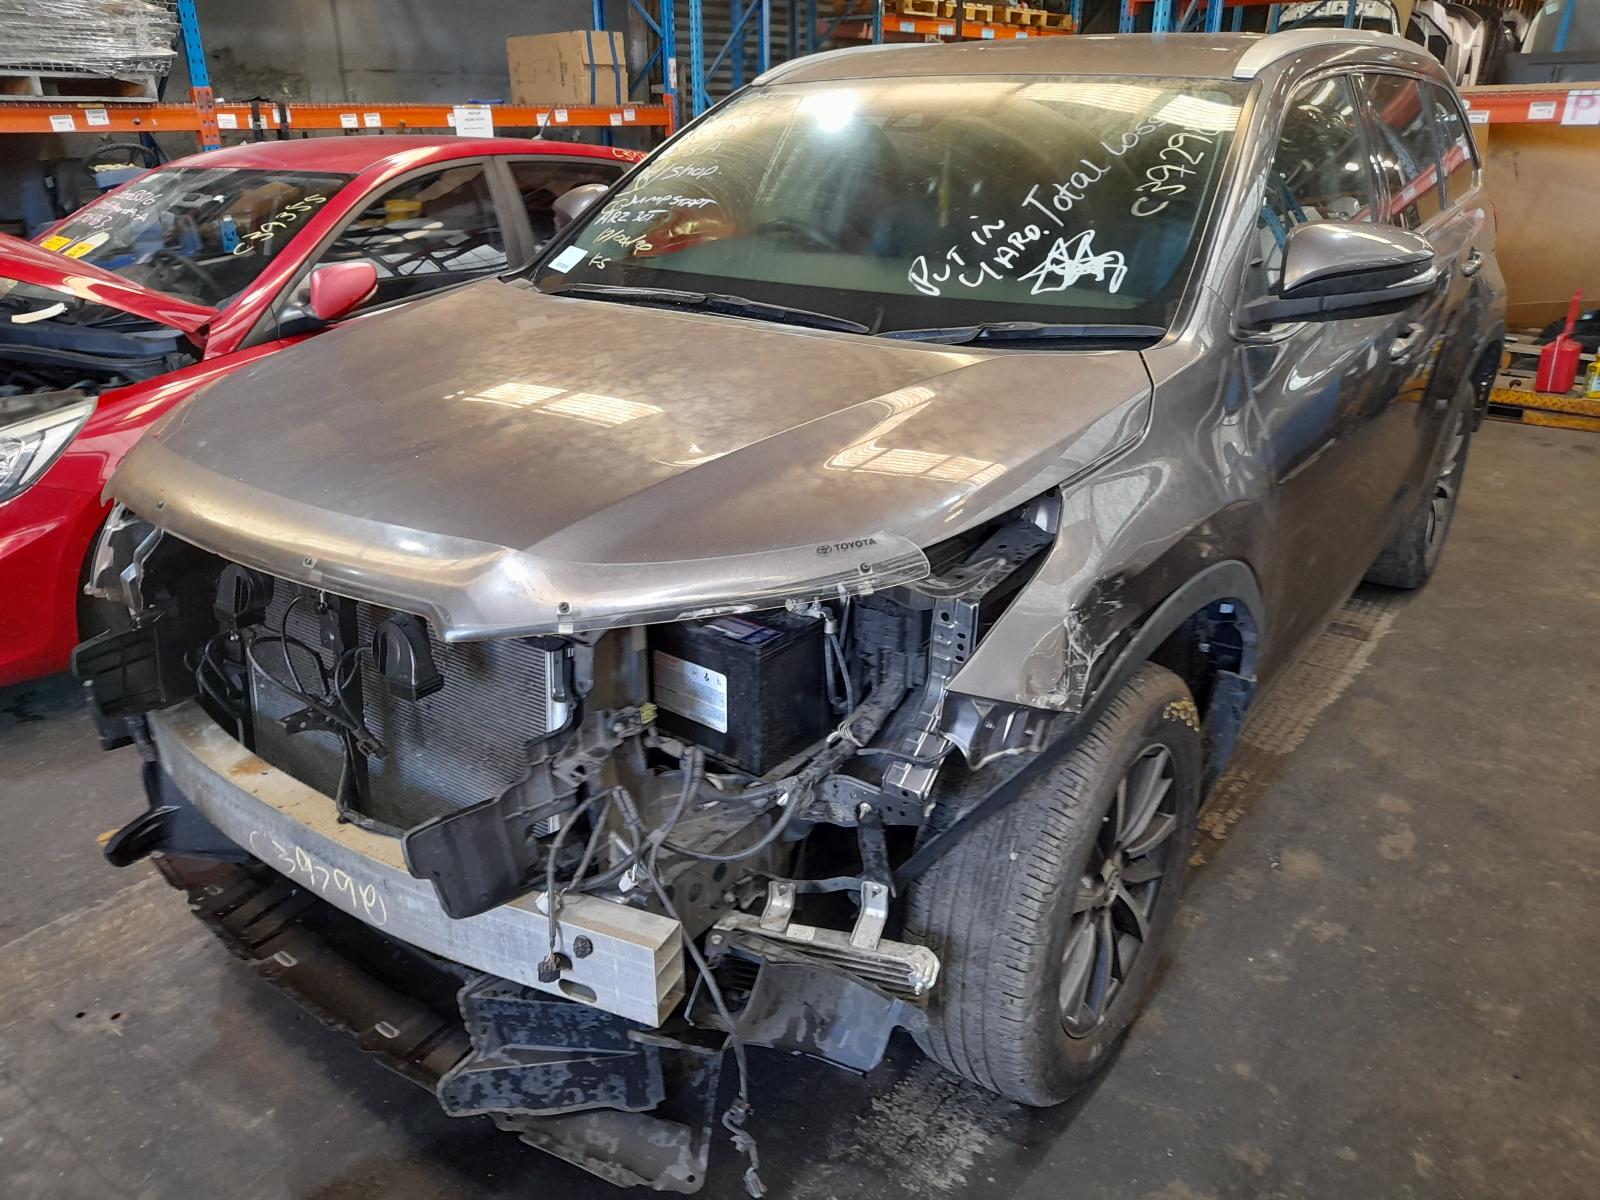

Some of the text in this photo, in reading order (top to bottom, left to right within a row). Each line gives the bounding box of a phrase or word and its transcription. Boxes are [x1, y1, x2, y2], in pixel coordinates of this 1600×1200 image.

[1022, 158, 1112, 227] Total
[908, 245, 965, 297] PUT
[834, 537, 878, 551] TOYOTA
